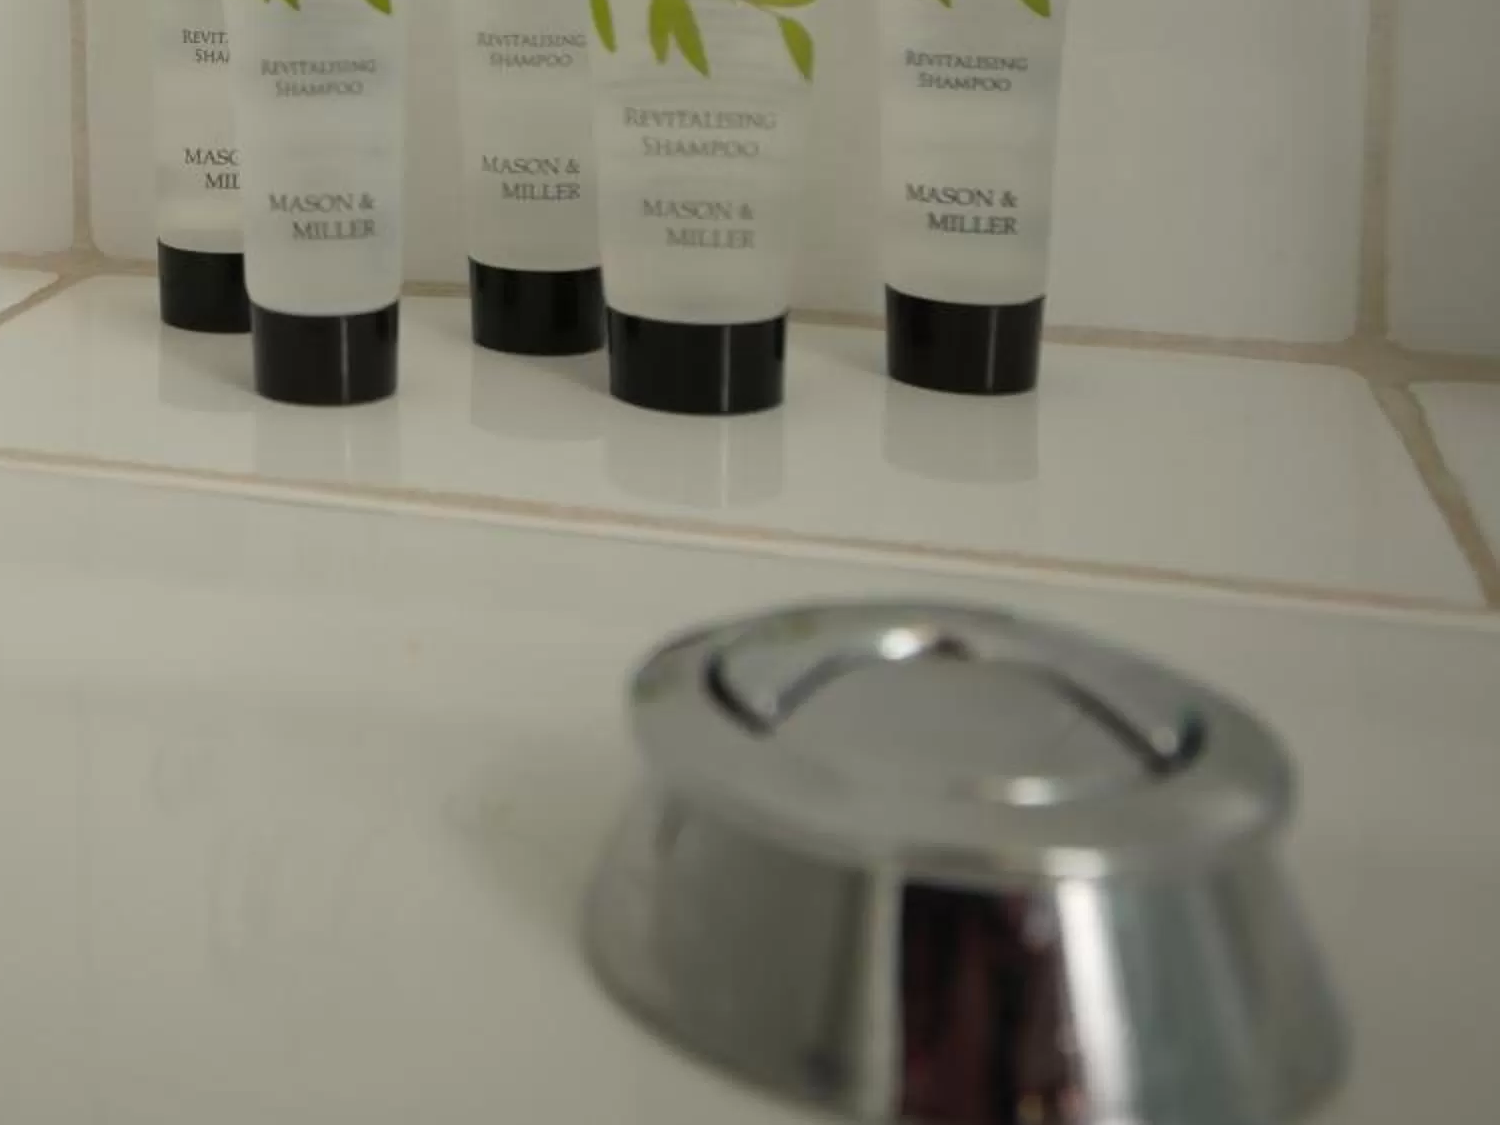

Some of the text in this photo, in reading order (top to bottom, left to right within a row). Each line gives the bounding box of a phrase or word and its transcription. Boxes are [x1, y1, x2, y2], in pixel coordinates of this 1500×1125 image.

[476, 31, 587, 48] REVITALISING
[261, 58, 377, 76] REVITALISING
[489, 51, 574, 68] SHAMPOO
[904, 49, 1029, 72] REVITALISING
[275, 80, 364, 97] SHAMPOO
[916, 73, 1012, 92] SHAMPOO
[623, 107, 777, 131] REVITALISING
[642, 135, 760, 158] SHAMPOO
[481, 155, 580, 174] MASON &
[501, 182, 581, 201] MILLER
[905, 183, 1019, 209] MASON &
[269, 193, 374, 213] MASON &
[642, 198, 754, 221] MASON &
[292, 219, 376, 241] MILLER
[927, 212, 1019, 236] MILLER
[665, 227, 756, 249] MILLER
